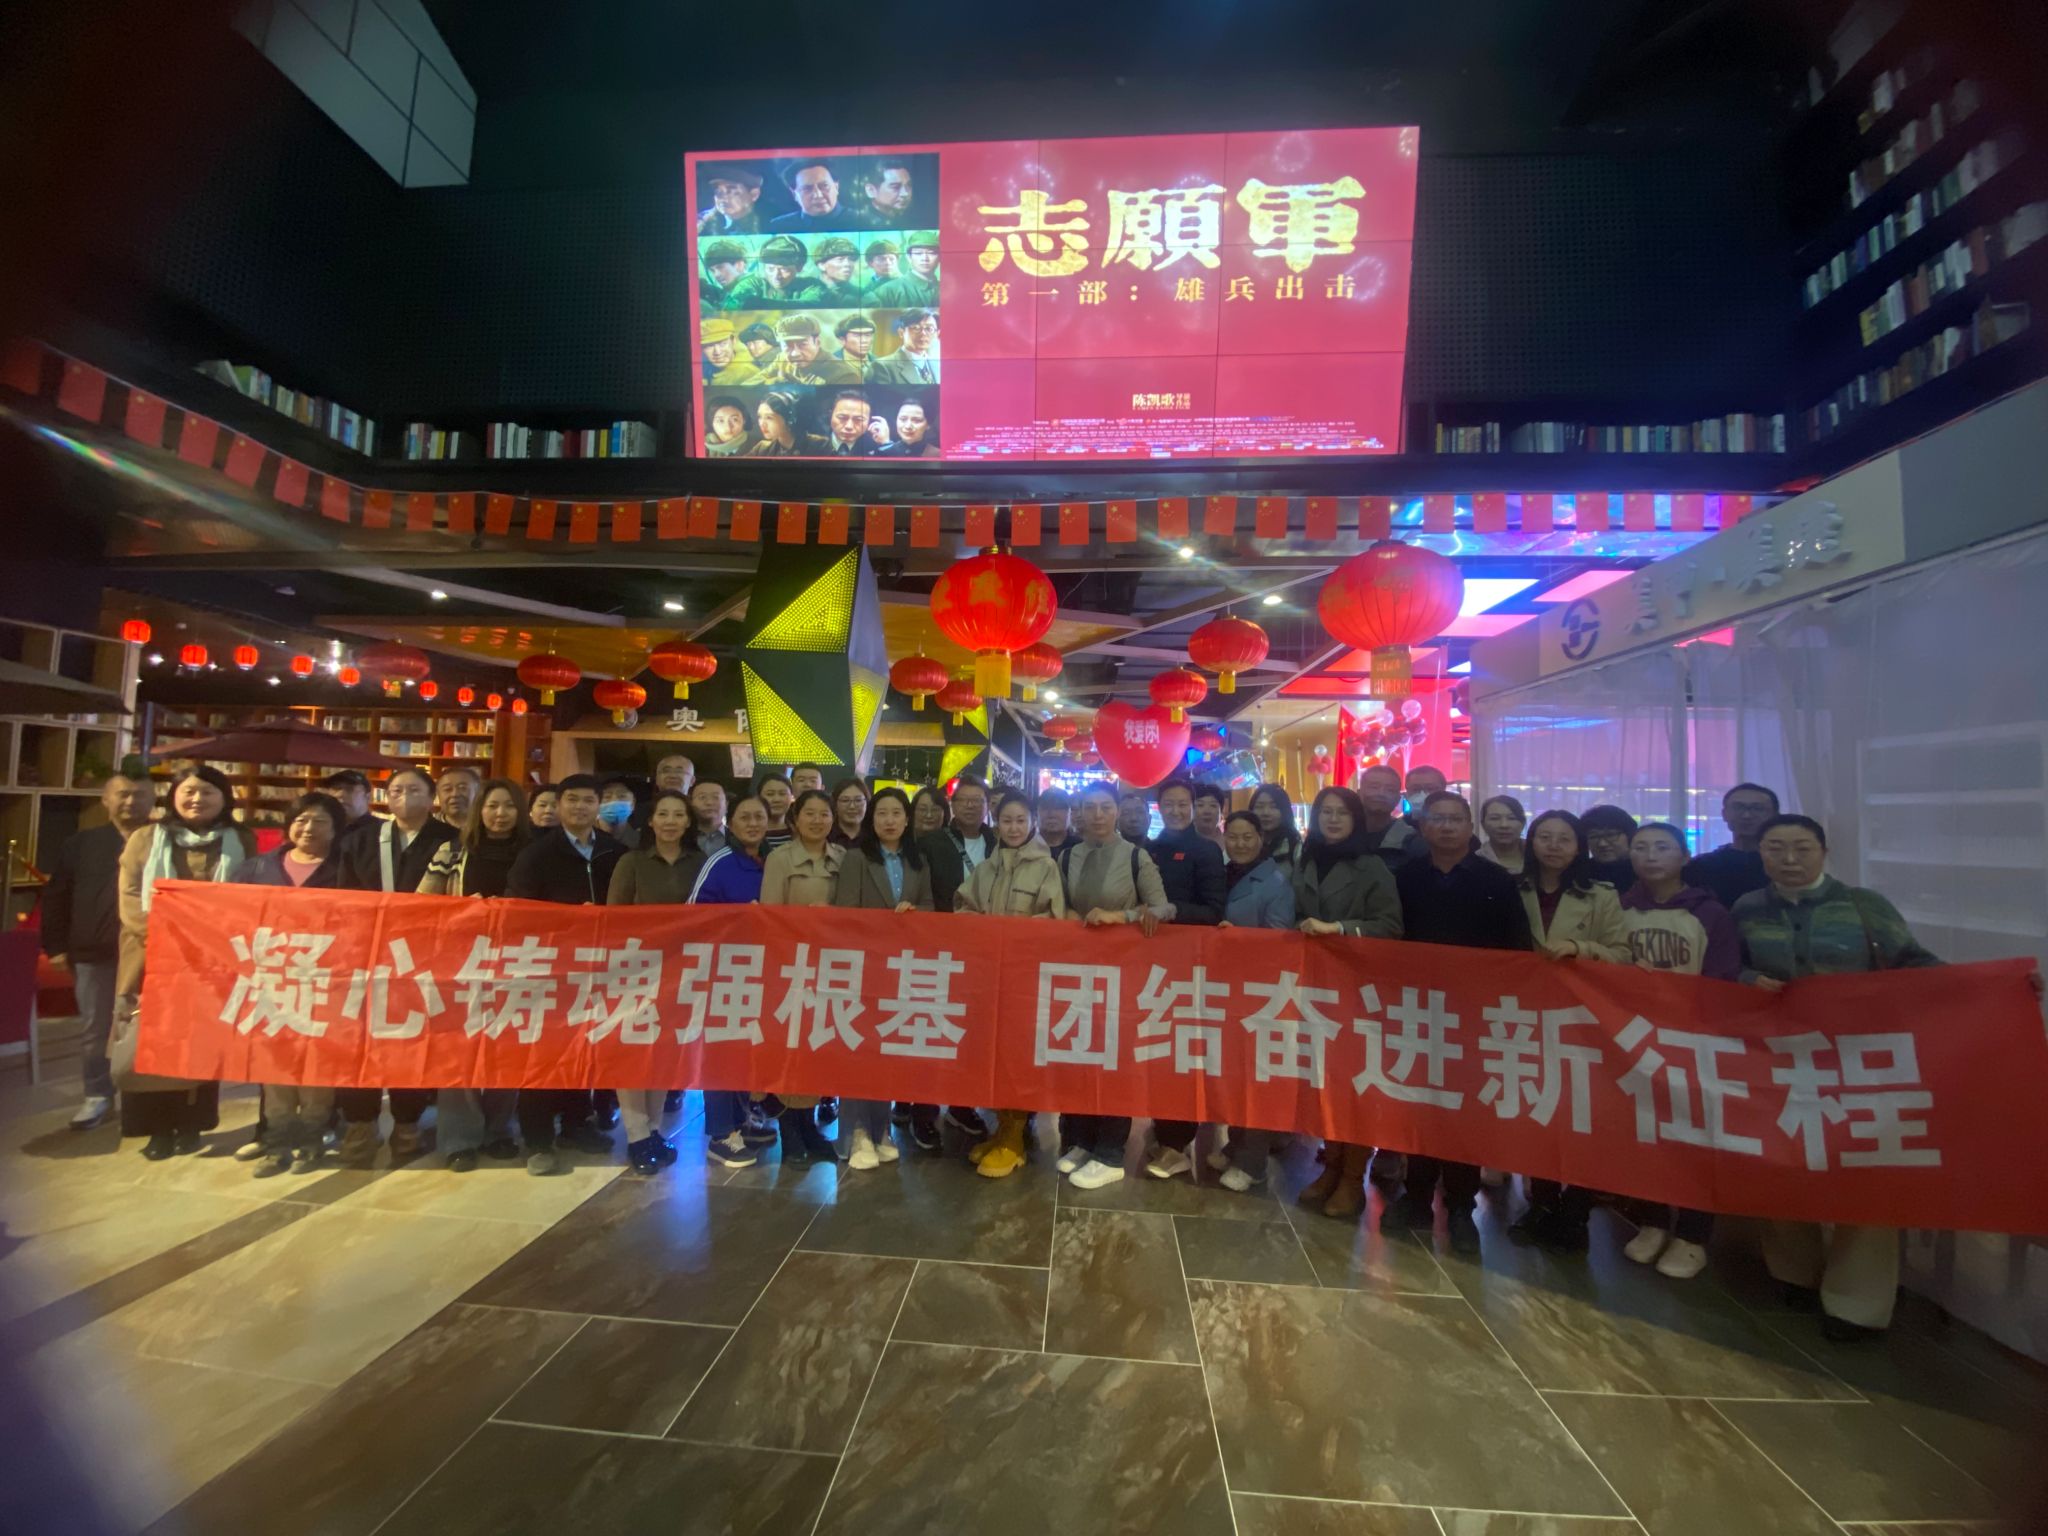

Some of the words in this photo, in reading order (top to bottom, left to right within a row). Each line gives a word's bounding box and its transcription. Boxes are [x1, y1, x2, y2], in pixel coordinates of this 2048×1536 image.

[977, 175, 1366, 277] 志願軍
[219, 927, 967, 1060] 凝心铸魂强根基
[1034, 962, 1942, 1171] 团结奋进新征程
